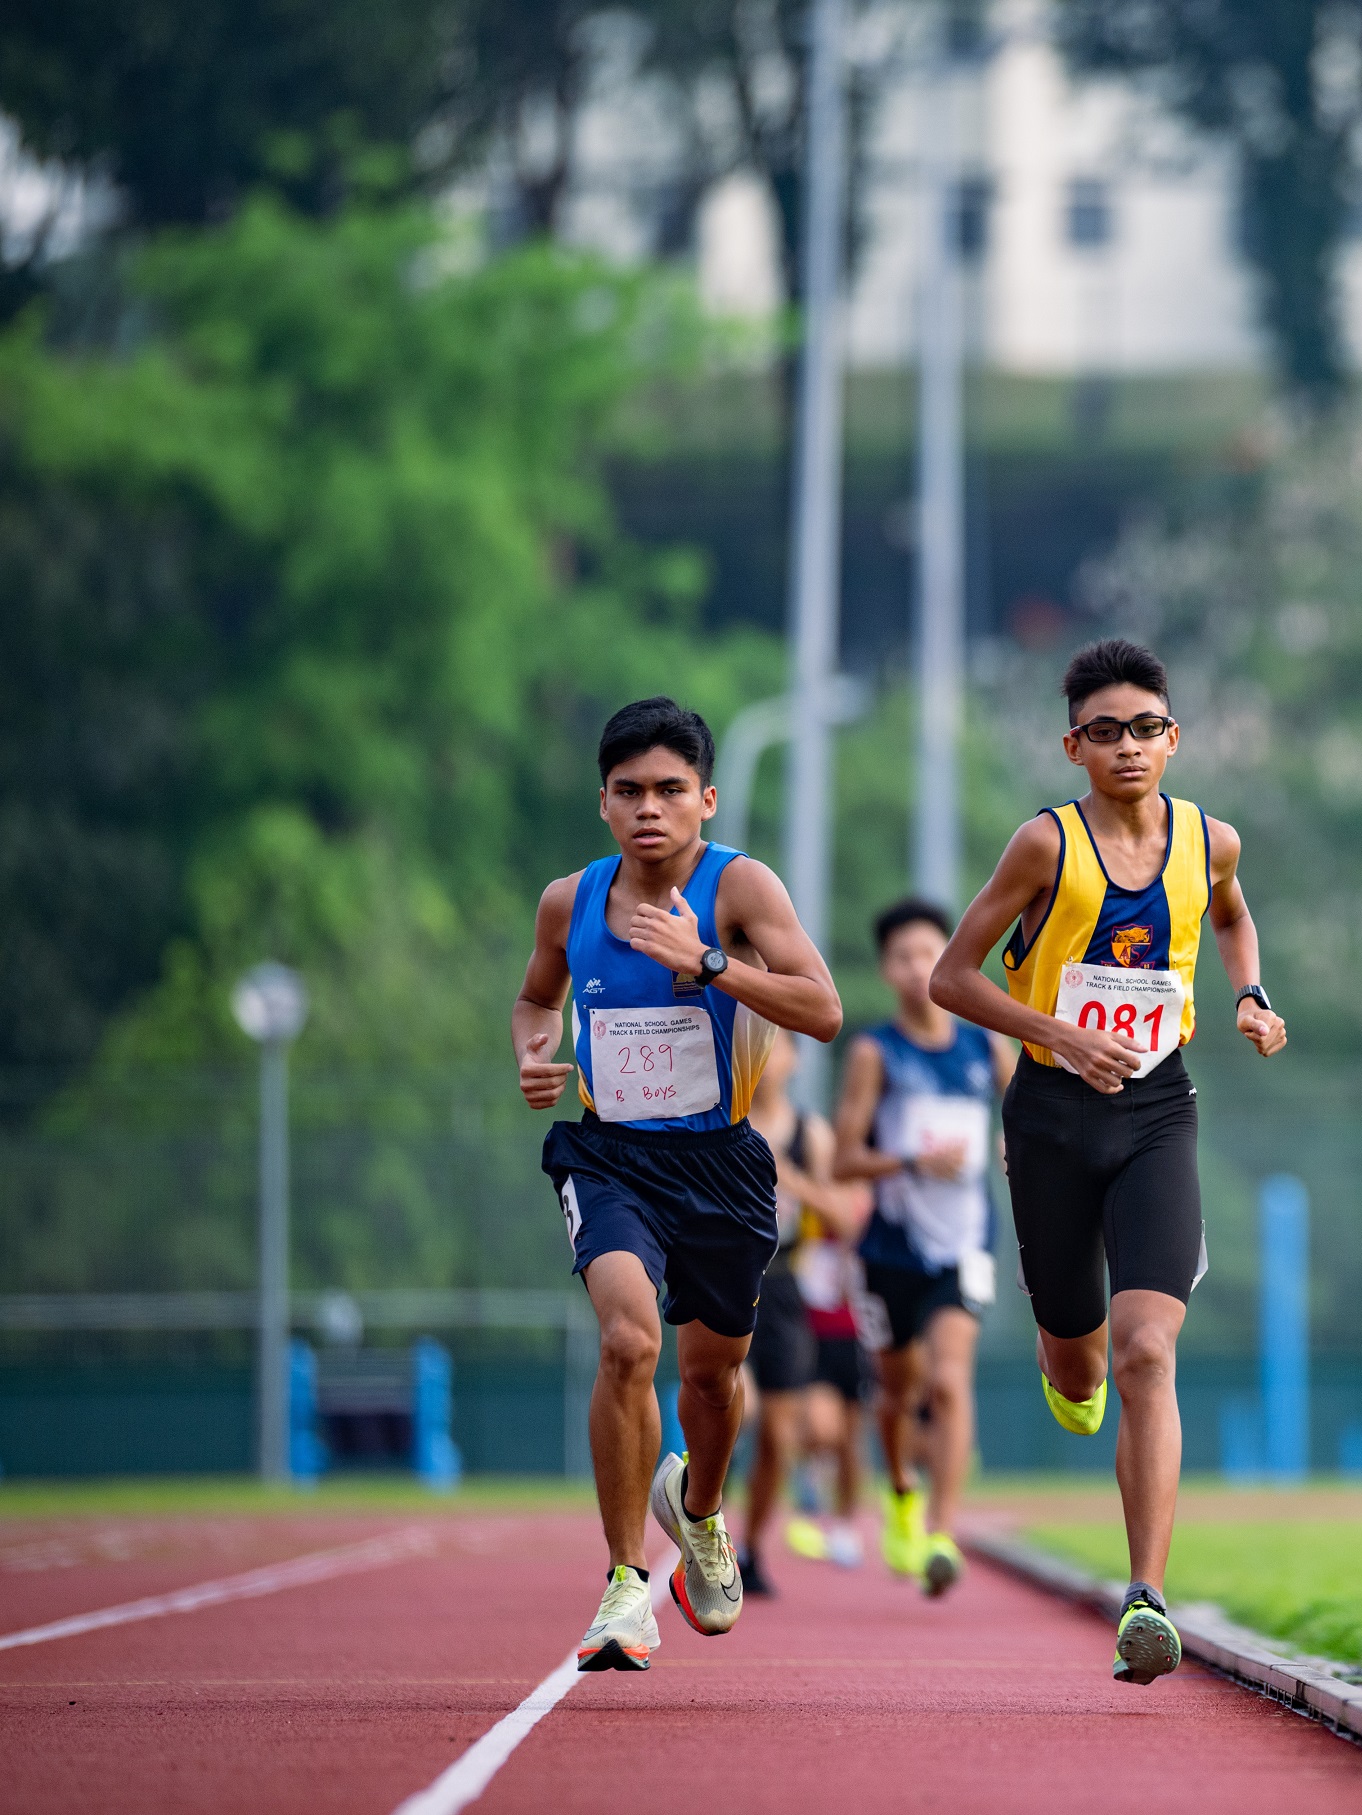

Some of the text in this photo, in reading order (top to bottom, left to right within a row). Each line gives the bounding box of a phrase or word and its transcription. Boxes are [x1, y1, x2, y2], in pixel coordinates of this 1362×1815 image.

[1086, 981, 1106, 989] TRACK
[1093, 975, 1122, 984] NATIONAL
[1151, 979, 1172, 987] GAMES
[670, 1017, 693, 1026] GAMES
[1077, 1000, 1165, 1052] 081
[651, 1024, 700, 1035] CHAMPIONSHIPS
[618, 1043, 673, 1074] 289
[615, 1089, 625, 1102] B
